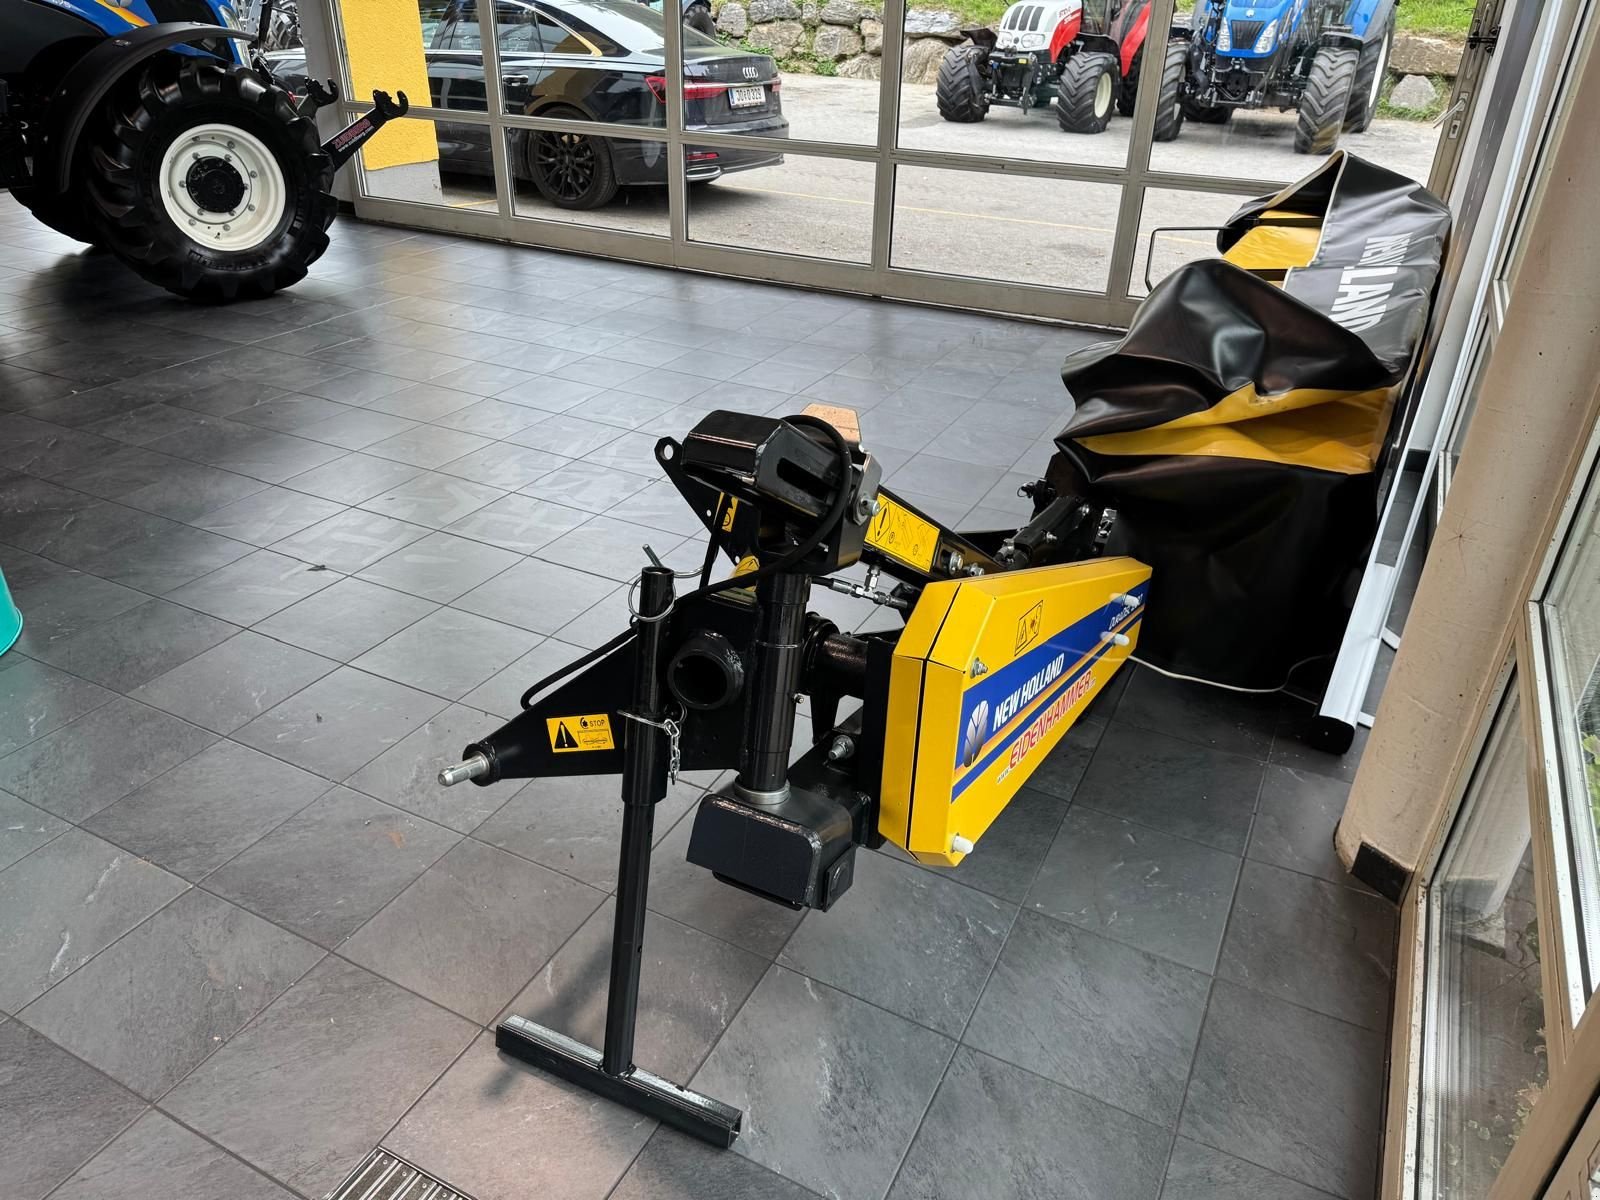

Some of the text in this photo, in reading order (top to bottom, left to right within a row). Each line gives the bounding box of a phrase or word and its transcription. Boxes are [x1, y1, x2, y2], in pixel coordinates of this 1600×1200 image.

[993, 652, 1065, 732] NEW HOLLAND
[589, 719, 605, 727] STOP
